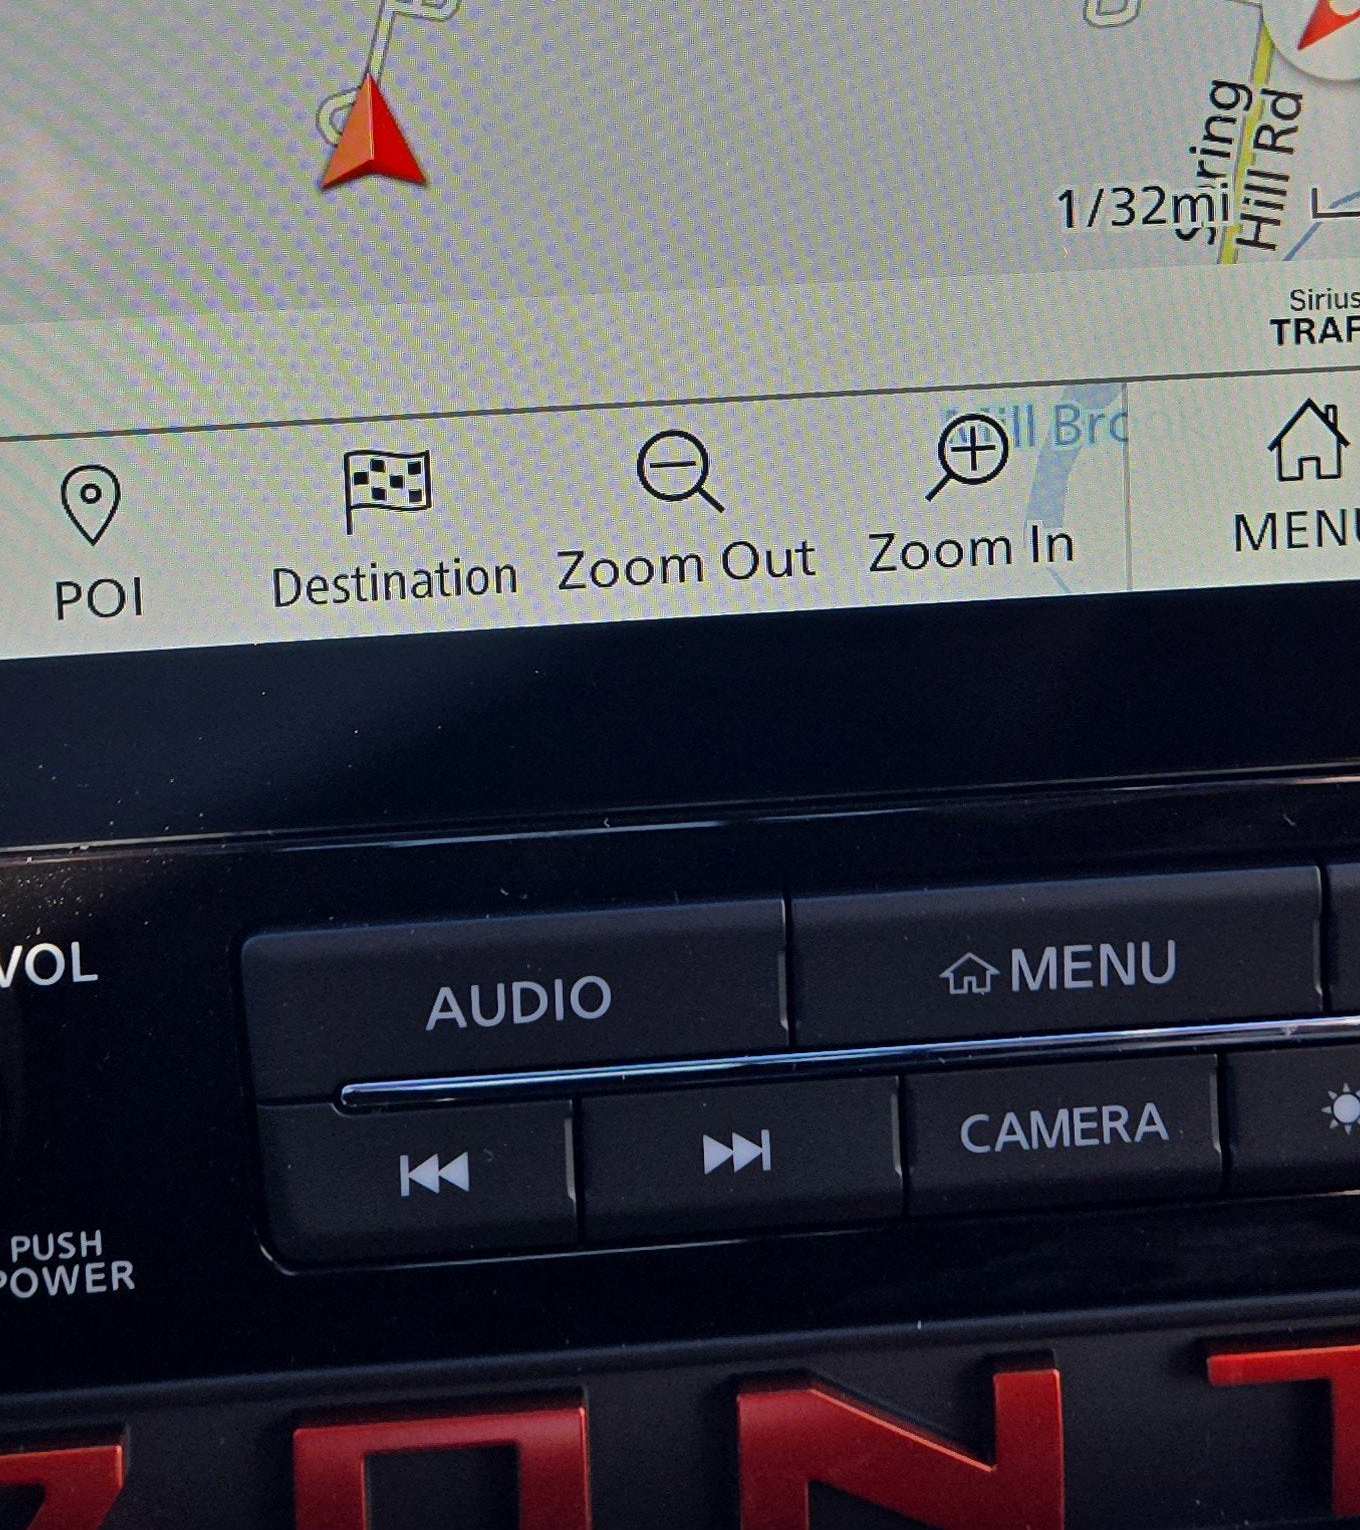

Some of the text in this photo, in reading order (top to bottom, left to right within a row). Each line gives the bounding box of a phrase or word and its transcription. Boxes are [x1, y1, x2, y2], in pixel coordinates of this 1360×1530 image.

[1235, 88, 1303, 251] Hill Rd
[1058, 182, 1230, 229] 1/32mi
[557, 539, 816, 590] Zoom Out
[869, 525, 1074, 571] Zoom In
[56, 576, 143, 620] POI
[273, 557, 518, 608] Destination
[1011, 940, 1176, 991] MENU
[426, 976, 612, 1031] AUDIO
[960, 1102, 1169, 1153] CAMERA
[11, 1230, 102, 1263] PUSH
